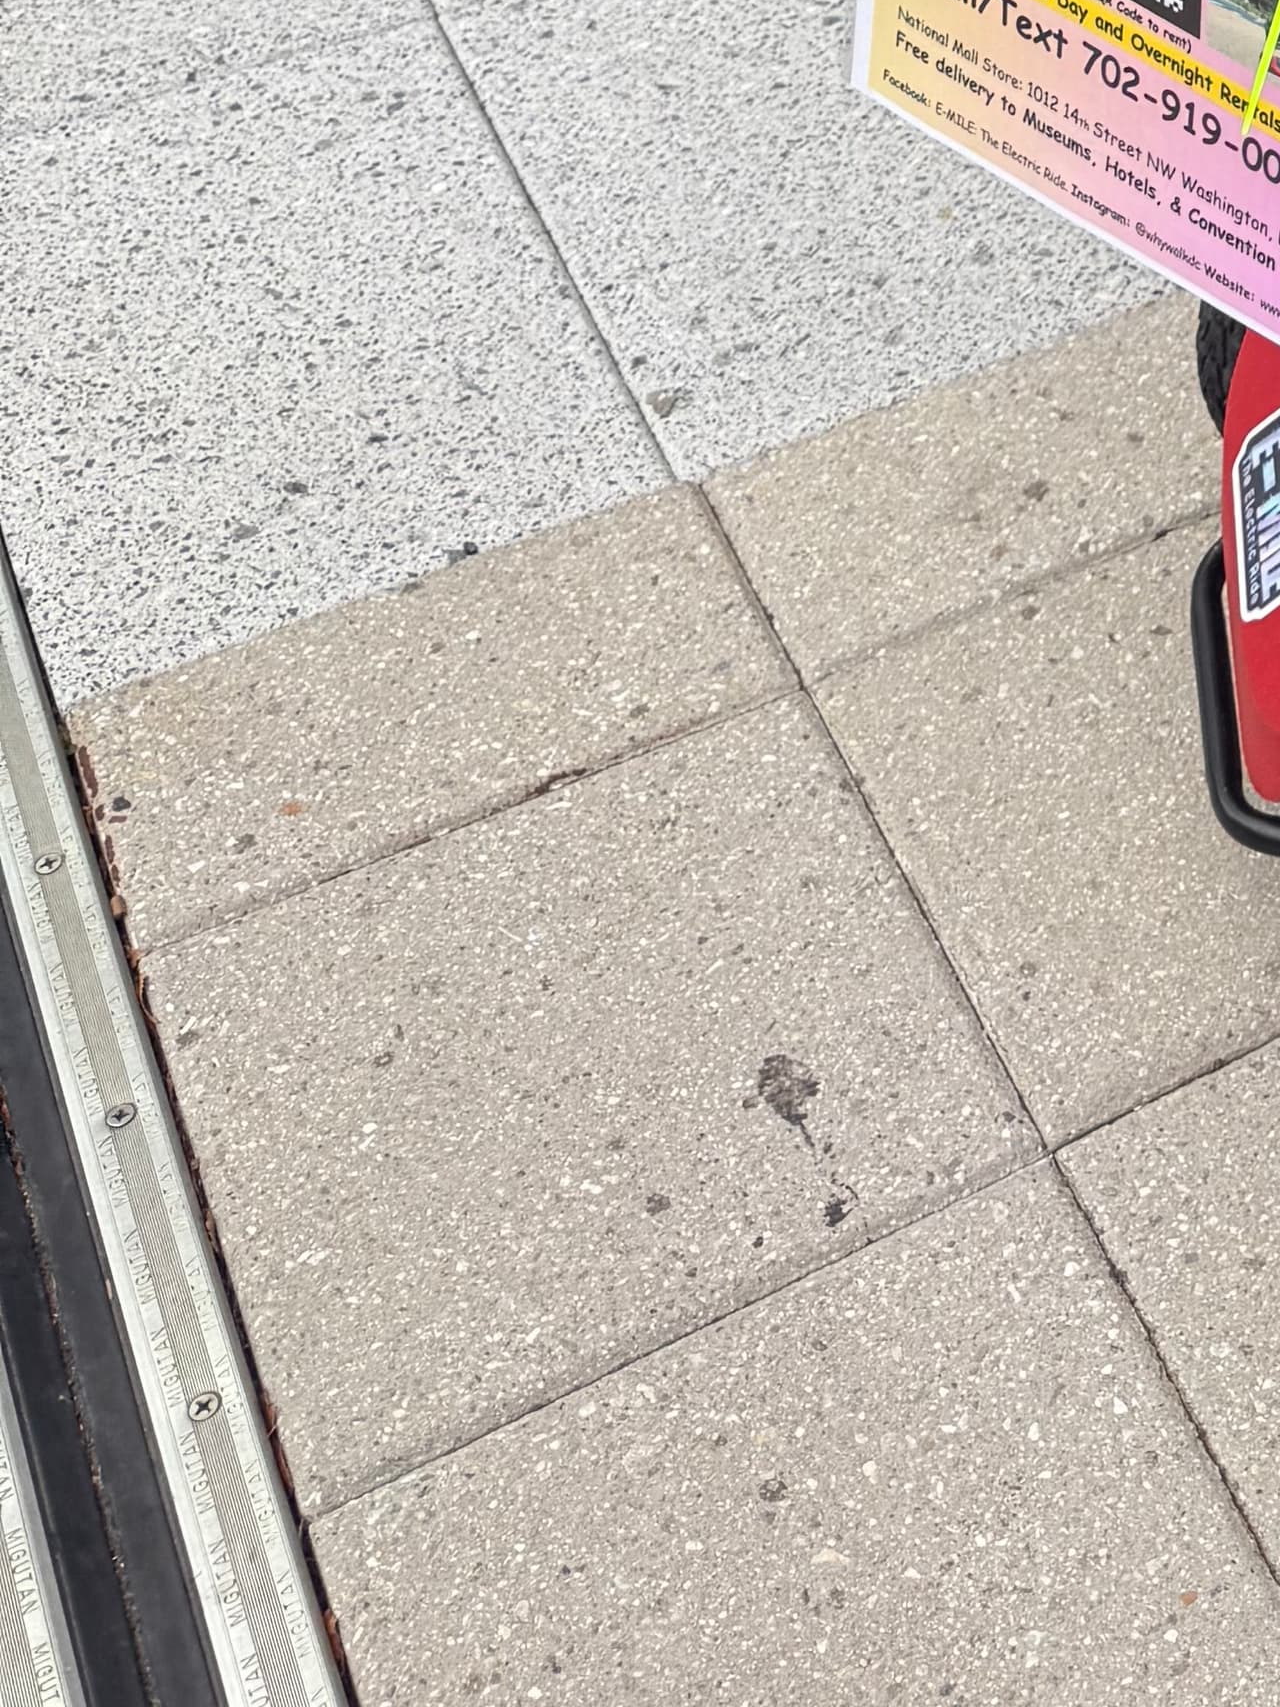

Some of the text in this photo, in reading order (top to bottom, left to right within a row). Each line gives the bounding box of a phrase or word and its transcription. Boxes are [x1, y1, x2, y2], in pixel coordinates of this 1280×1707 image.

[1095, 14, 1124, 42] and
[1130, 34, 1214, 92] Overnight
[1116, 1, 1143, 24] Code
[1147, 18, 1160, 35] to
[1163, 29, 1192, 54] rent)
[895, 30, 929, 65] Free
[935, 57, 996, 107] delivery
[1000, 95, 1017, 117] to
[1022, 108, 1097, 168] Museums,
[1104, 155, 1162, 206] Hotels,
[1169, 196, 1183, 217] &
[1188, 207, 1276, 272] Convention
[897, 5, 950, 48] National
[951, 39, 979, 66] Mall
[982, 57, 1023, 91] Store:
[1026, 81, 1059, 113] 1012
[1064, 102, 1091, 131] 14th
[1092, 121, 1143, 162] Street
[1146, 151, 1177, 181] NW
[1181, 171, 1273, 242] Washington,
[882, 69, 932, 108] Facebook:
[980, 127, 999, 150] The
[1001, 141, 1041, 175] Electric
[1070, 183, 1131, 228] Instagram:
[1203, 262, 1256, 303] Website:
[1243, 488, 1257, 561] Electric
[1248, 564, 1259, 605] Ride
